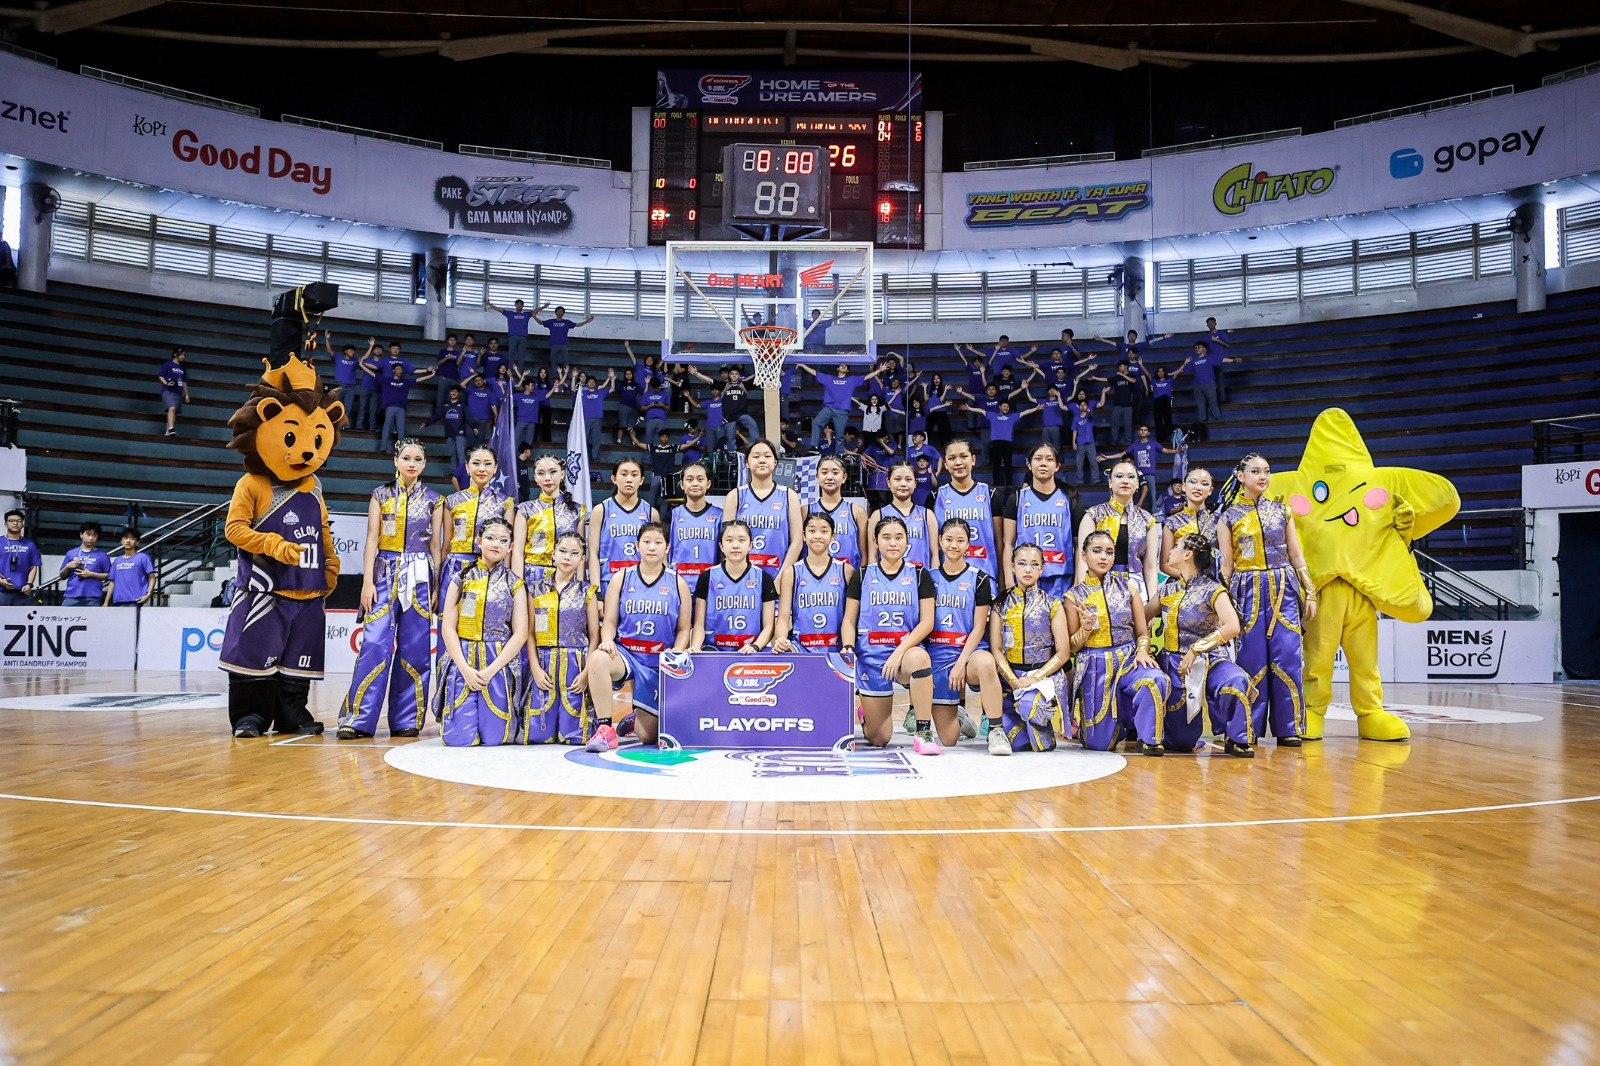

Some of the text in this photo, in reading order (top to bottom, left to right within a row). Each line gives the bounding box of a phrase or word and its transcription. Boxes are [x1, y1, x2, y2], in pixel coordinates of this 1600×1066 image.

[759, 79, 820, 91] HOME
[759, 91, 878, 104] DREAMERS
[653, 118, 667, 128] 00
[878, 121, 891, 131] 01
[915, 121, 922, 131] 2
[878, 132, 922, 141] 04 6
[1433, 125, 1546, 174] gopay
[172, 129, 260, 175] Good
[267, 147, 332, 196] Day
[845, 176, 860, 184] FOULS
[441, 183, 580, 208] PAKE STREET
[968, 192, 1008, 206] YANG
[1009, 189, 1062, 204] WORTH
[1084, 186, 1104, 200] YA
[1106, 183, 1148, 197] CUMA
[467, 210, 490, 224] GAYA
[493, 210, 524, 224] MAKIN
[651, 209, 696, 221] 23 0
[707, 273, 735, 287] One
[944, 507, 980, 521] GLORIA
[1023, 513, 1064, 529] GLORIA 1
[776, 515, 781, 530] 1
[677, 527, 716, 541] GLORIA 1
[1033, 532, 1056, 548] 12
[623, 542, 636, 556] 8
[753, 535, 767, 550] 6
[298, 543, 319, 569] 01
[693, 545, 699, 559] 1
[715, 594, 755, 611] GLORIA 1
[798, 591, 835, 608] GLORIA
[869, 590, 913, 606] GLORIA 1
[625, 598, 668, 616] GLORIA 1
[727, 615, 747, 630] 16
[813, 613, 828, 629] 9
[877, 611, 905, 627] 25
[940, 613, 954, 628] 4
[635, 620, 656, 636] 13
[3, 623, 87, 657] ZINC
[56, 660, 87, 668] SHAMPOO
[298, 654, 312, 667] 01
[1427, 646, 1492, 667] Bioré
[742, 678, 760, 687] DBL
[762, 696, 775, 704] Day
[699, 717, 815, 732] PLAYOFFS
